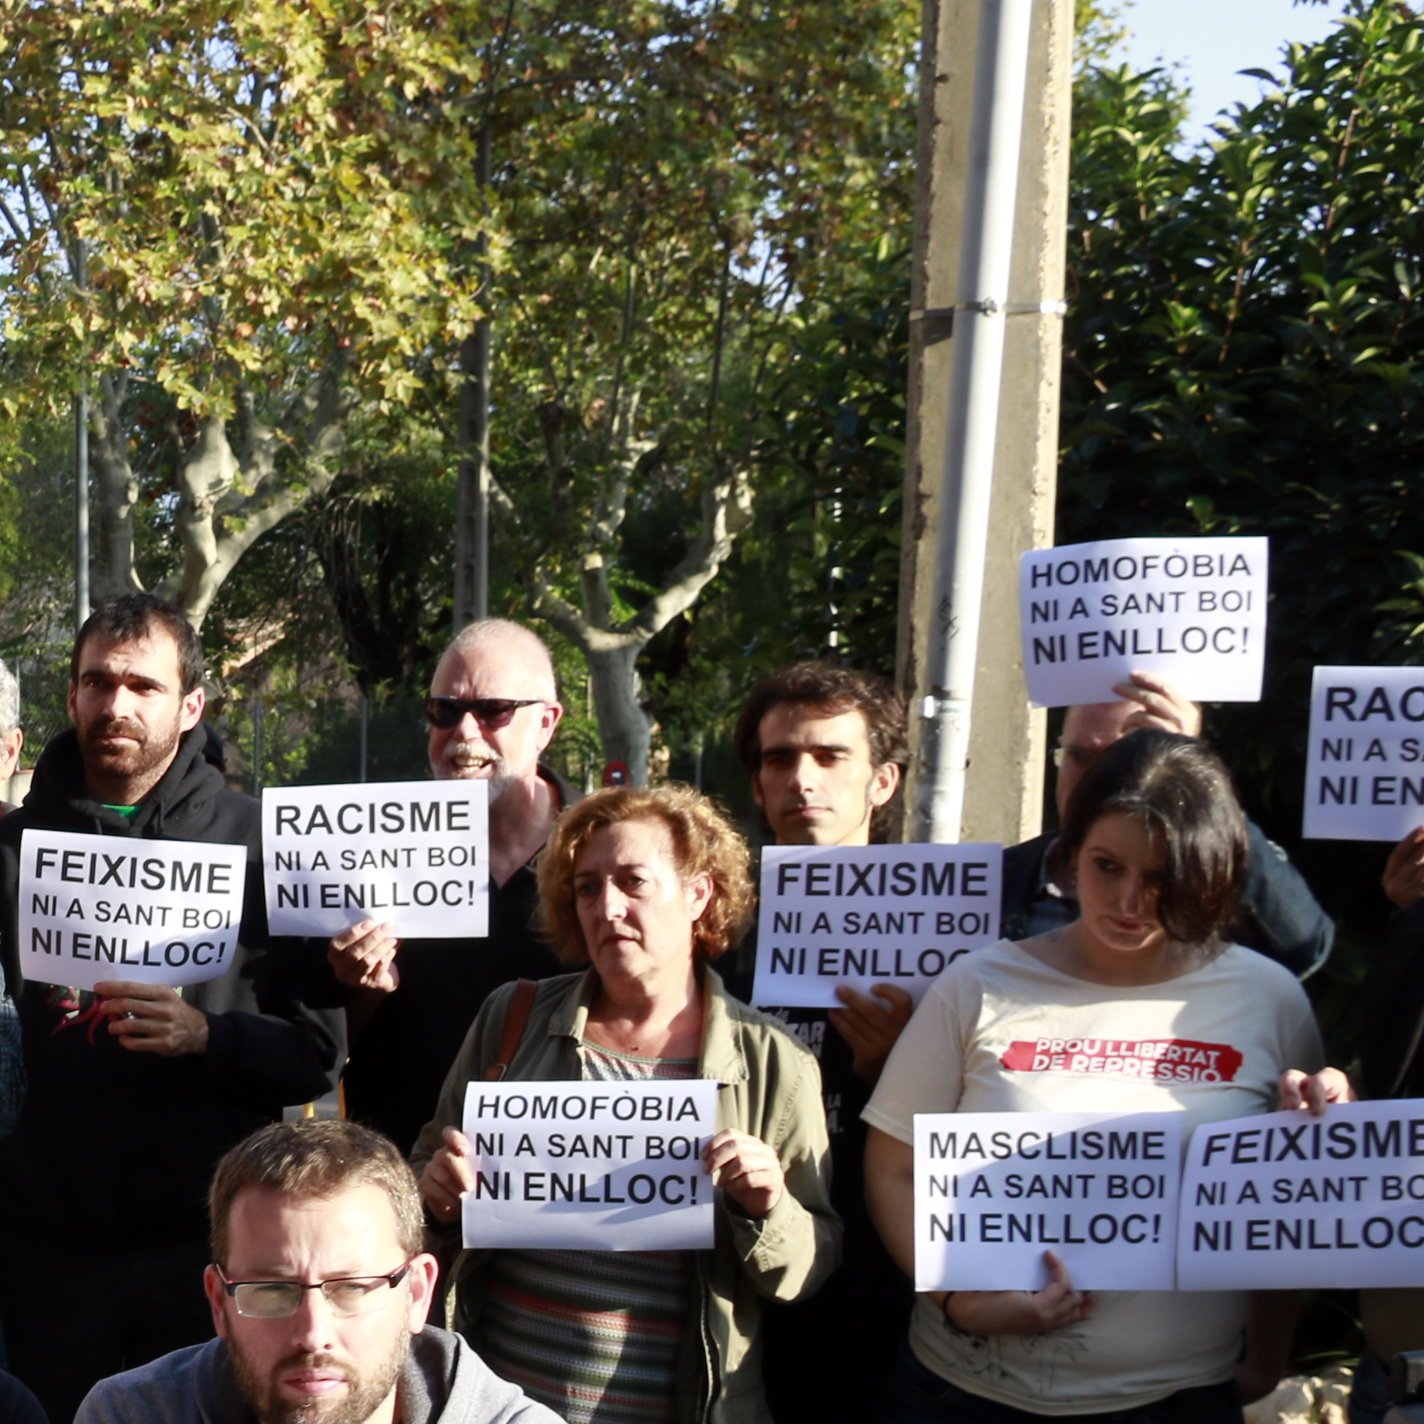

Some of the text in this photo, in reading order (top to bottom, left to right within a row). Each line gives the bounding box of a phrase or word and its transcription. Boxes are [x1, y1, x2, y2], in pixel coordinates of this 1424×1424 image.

[1031, 551, 1251, 588] HOMOFÒBIA
[1031, 590, 1251, 624] NI A SANT BOI
[1033, 626, 1248, 665] NI ENLLOC!
[276, 800, 470, 836] RACISME
[35, 848, 232, 894] FEIXISME
[275, 846, 475, 871] NI A SANT BOI
[277, 880, 474, 909] NI ENLLOC!
[777, 862, 988, 896] FEIXISME
[32, 893, 231, 929] NI A SANT BOI
[773, 912, 989, 935] NI A SANT BOI
[32, 927, 226, 967] NI ENLLOC!
[1032, 1055, 1221, 1082] DE REPRESSIÓ
[1035, 1038, 1221, 1067] PROU LLIBERTAT
[478, 1088, 700, 1121] HOMOFÒBIA
[476, 1133, 699, 1160] NI A SANT BOI
[930, 1131, 1165, 1160] MASCLISME
[476, 1171, 697, 1205] NI ENLLOC!
[929, 1174, 1165, 1199] NI A SANT BOI
[1196, 1176, 1368, 1206] NI A SANT
[930, 1213, 1161, 1244] NI ENLLOC!
